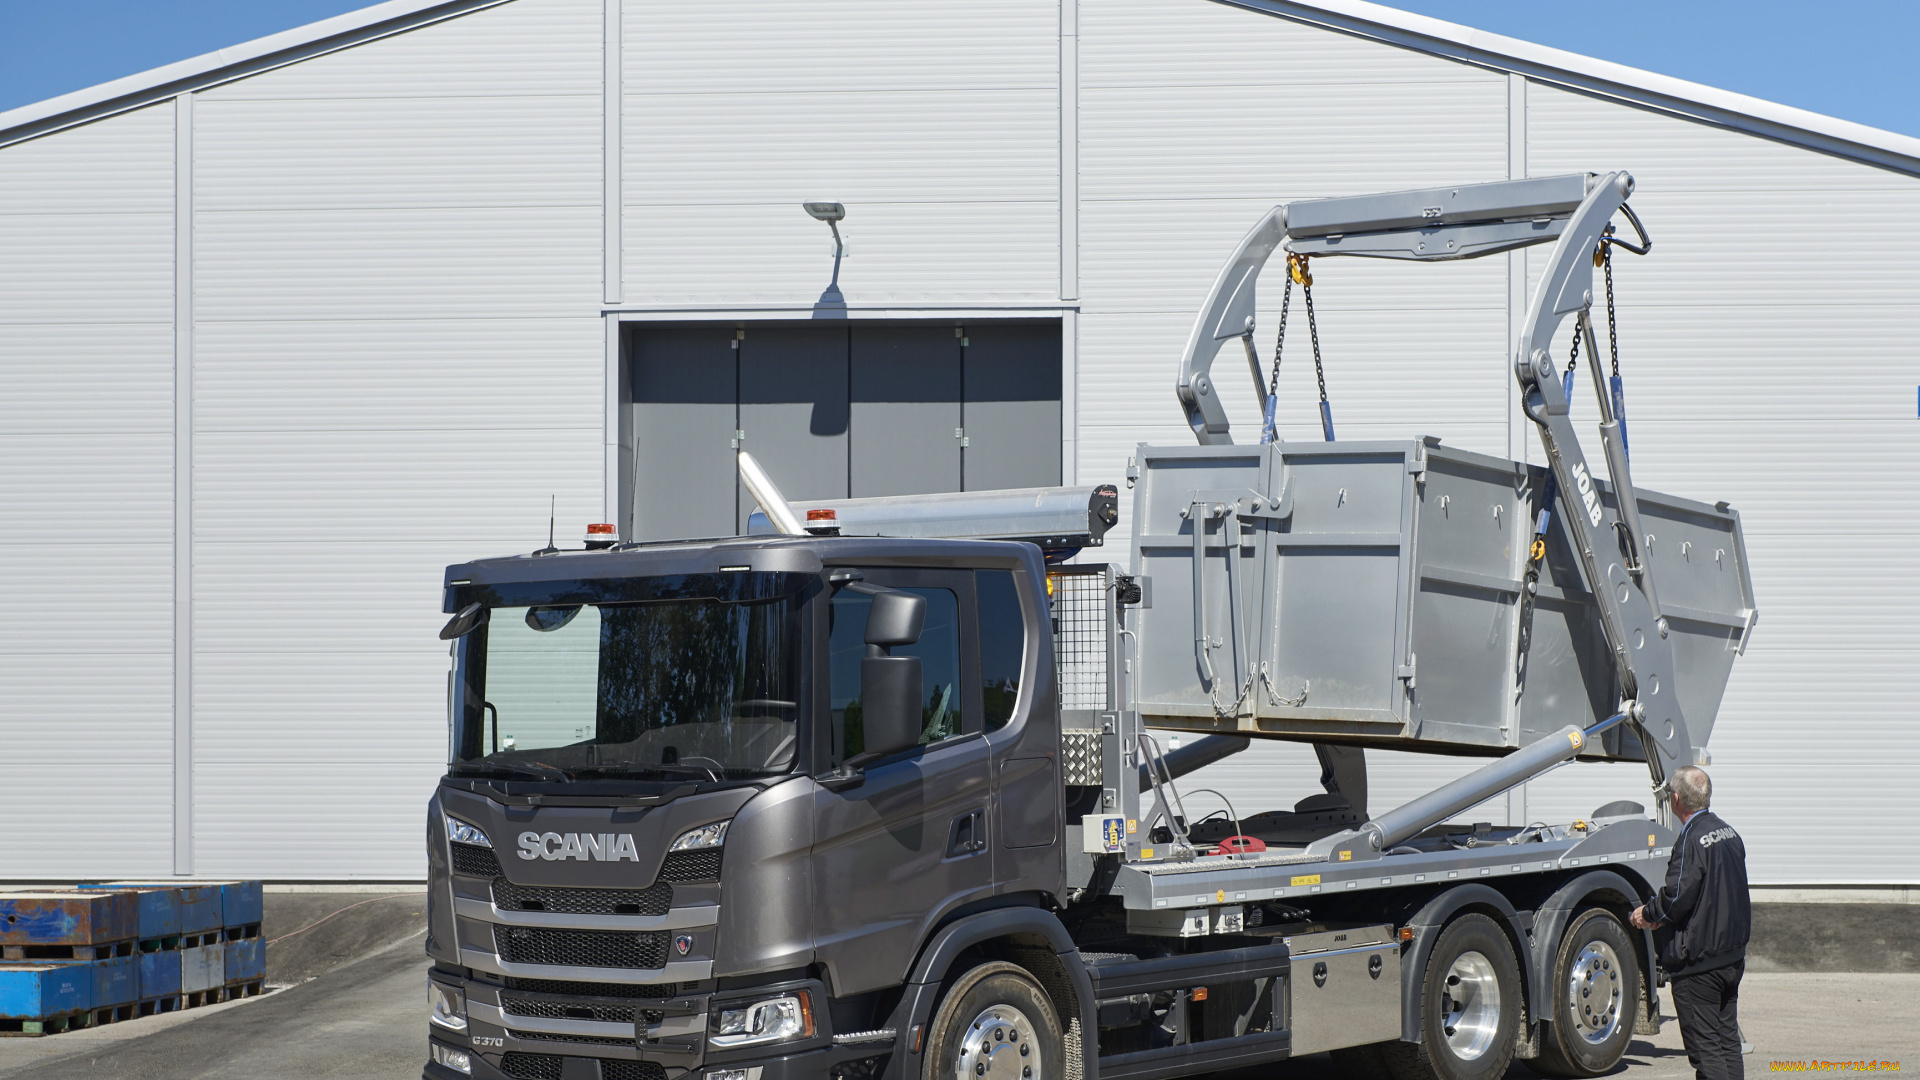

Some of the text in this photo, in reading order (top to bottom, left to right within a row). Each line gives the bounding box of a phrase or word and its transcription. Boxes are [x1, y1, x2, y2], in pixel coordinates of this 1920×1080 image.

[1572, 462, 1602, 527] JOAB
[516, 831, 640, 862] SCANIA
[1699, 827, 1737, 848] SCANIA
[1334, 934, 1347, 942] JOAB
